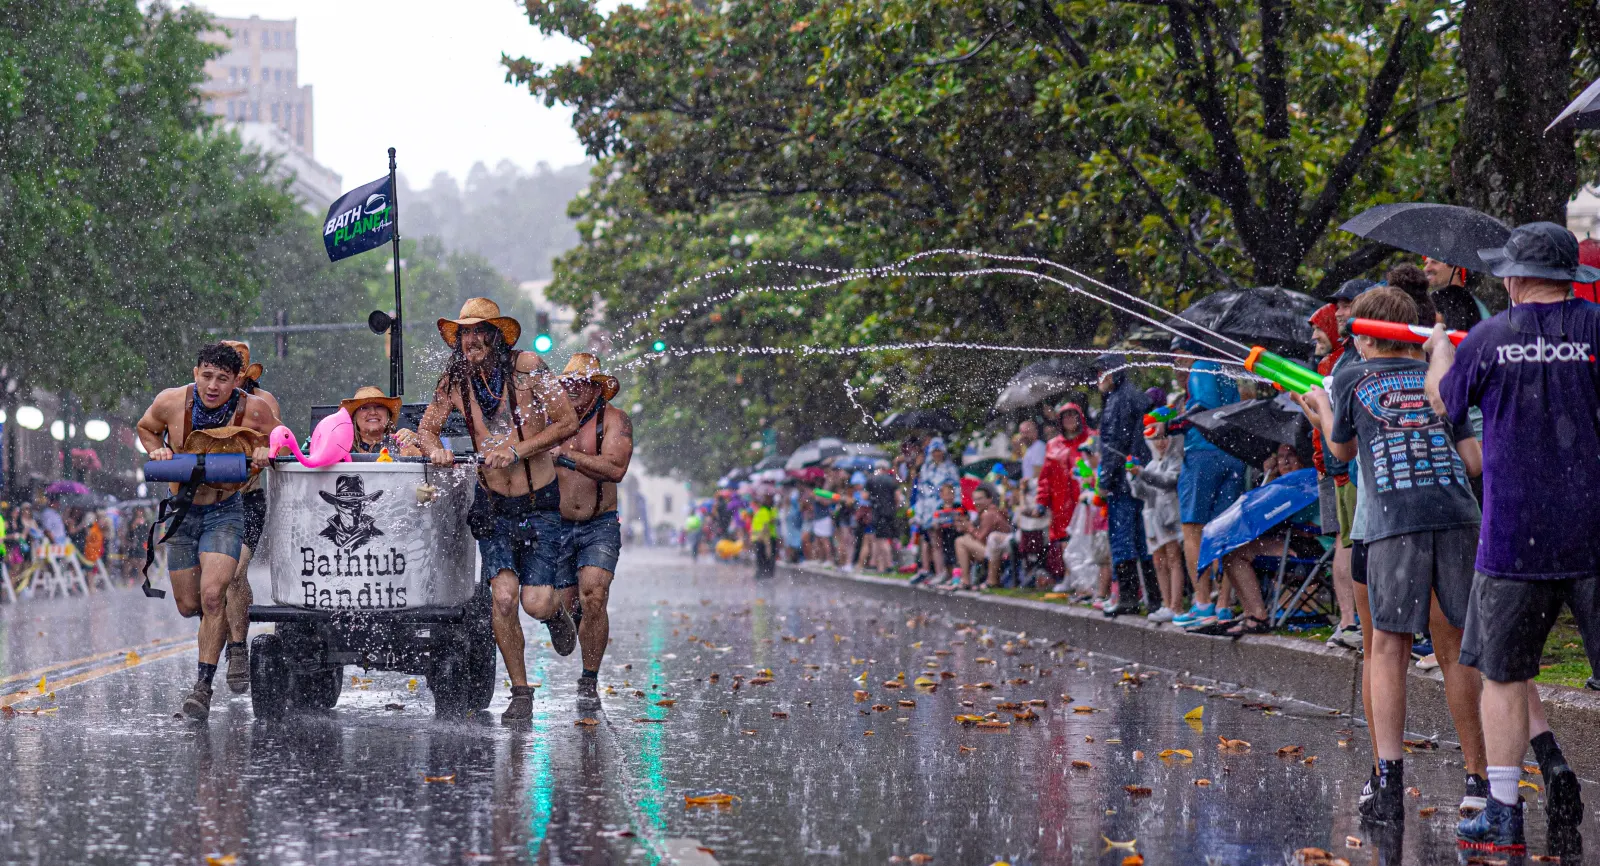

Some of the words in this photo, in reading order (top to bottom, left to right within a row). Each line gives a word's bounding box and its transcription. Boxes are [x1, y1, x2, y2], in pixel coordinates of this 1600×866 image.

[324, 205, 362, 236] BATH
[334, 205, 392, 246] PLANET
[1356, 376, 1402, 406] RALPH
[301, 546, 407, 577] Bathtub
[302, 581, 407, 610] Bandits
